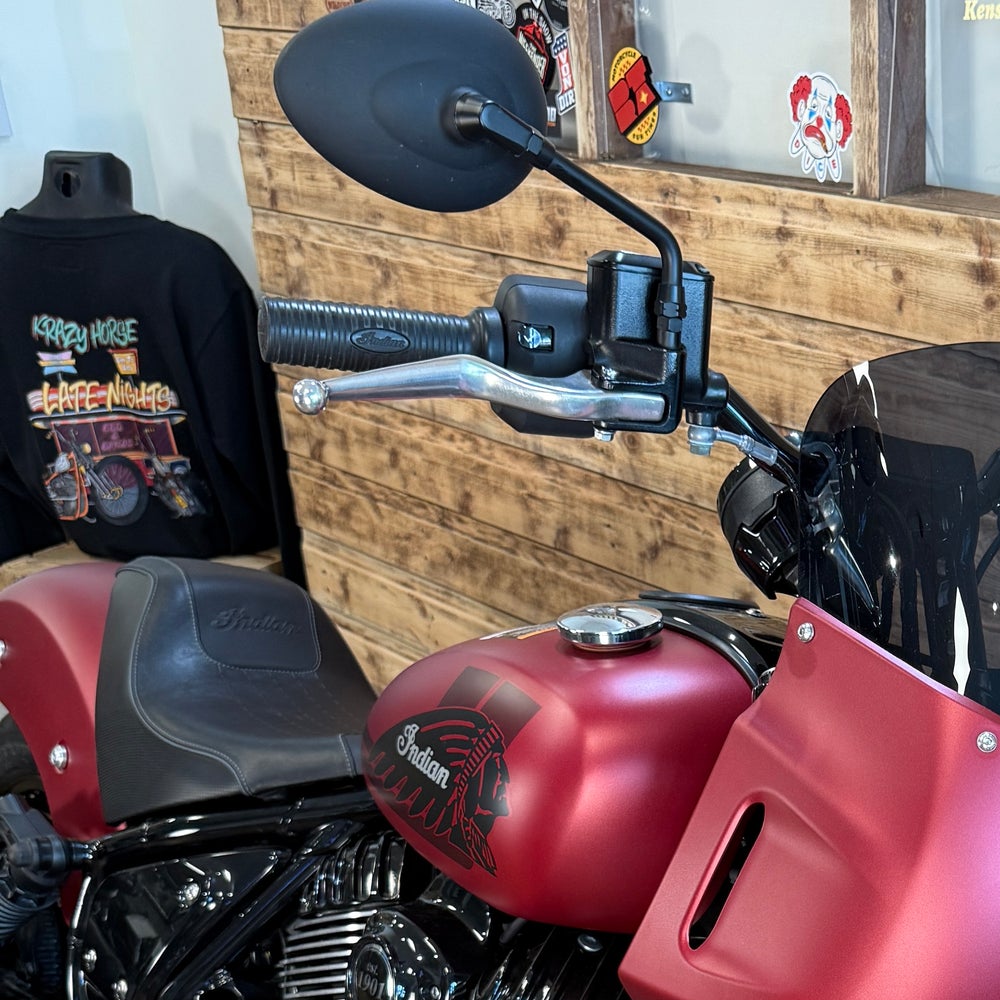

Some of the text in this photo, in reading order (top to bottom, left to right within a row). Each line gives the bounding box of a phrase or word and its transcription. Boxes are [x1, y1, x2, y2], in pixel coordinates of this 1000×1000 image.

[32, 315, 138, 353] KRAZY HORSE
[42, 380, 100, 416] LATE
[396, 723, 450, 790] Indian
[358, 971, 385, 999] 1901
